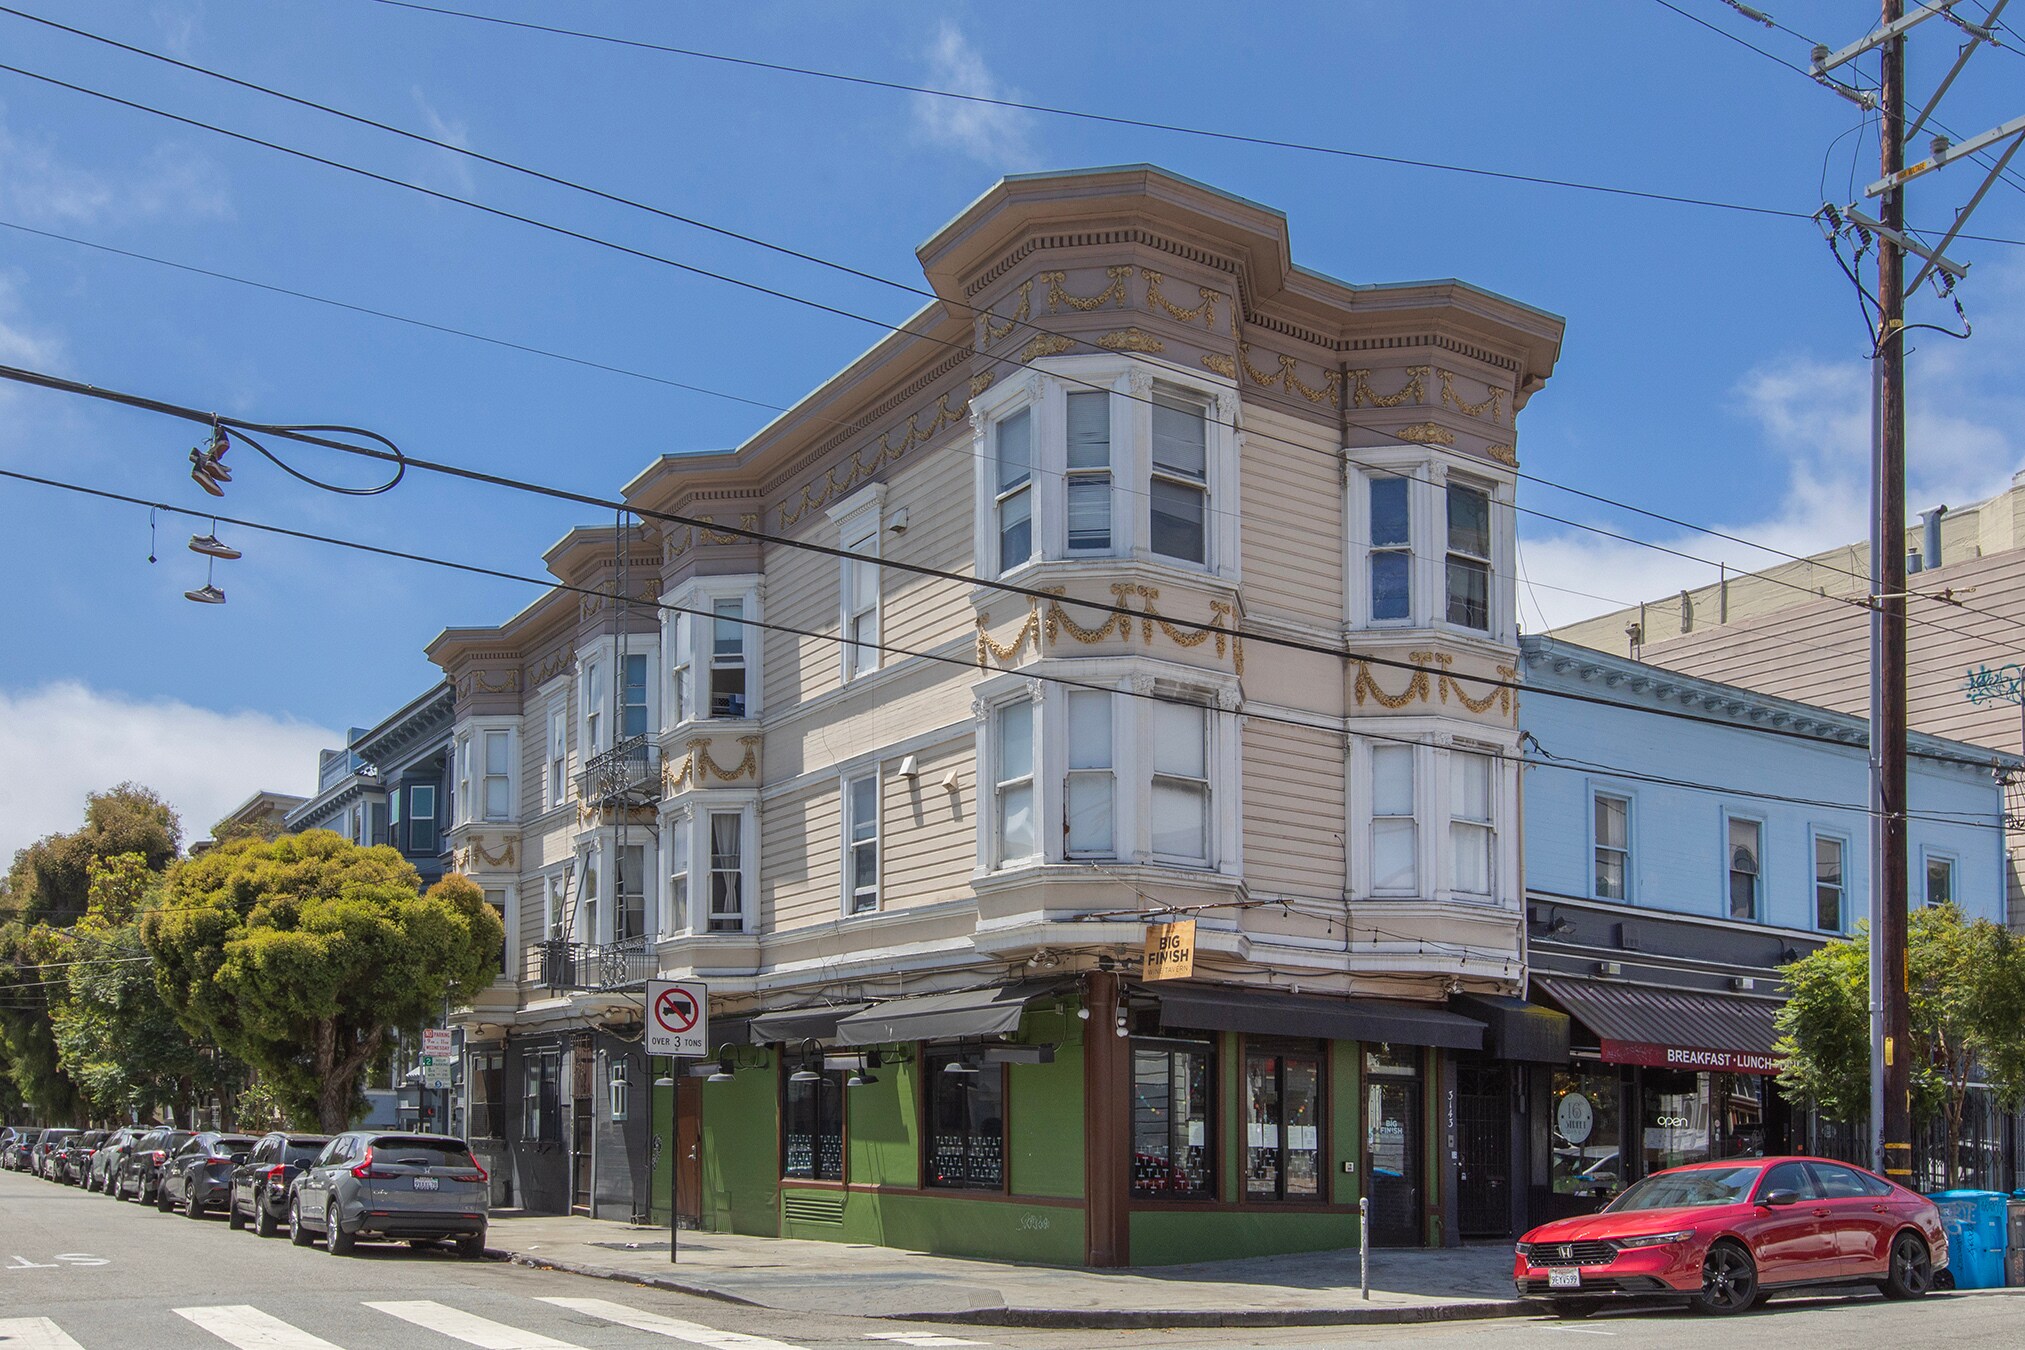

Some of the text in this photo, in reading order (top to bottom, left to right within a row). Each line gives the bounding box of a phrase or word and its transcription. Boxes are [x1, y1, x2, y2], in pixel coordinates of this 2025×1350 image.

[1160, 935, 1180, 950] BIG
[1148, 948, 1189, 966] FINISH
[1165, 965, 1188, 973] TAVERN
[651, 1035, 702, 1048] OVER 3 TONS
[425, 1057, 432, 1066] 2
[1667, 1049, 1731, 1066] BREAKFAST
[1737, 1056, 1772, 1070] LUNCH
[1385, 1119, 1398, 1128] BIG
[1657, 1116, 1688, 1128] open
[1380, 1127, 1403, 1135] FINISH
